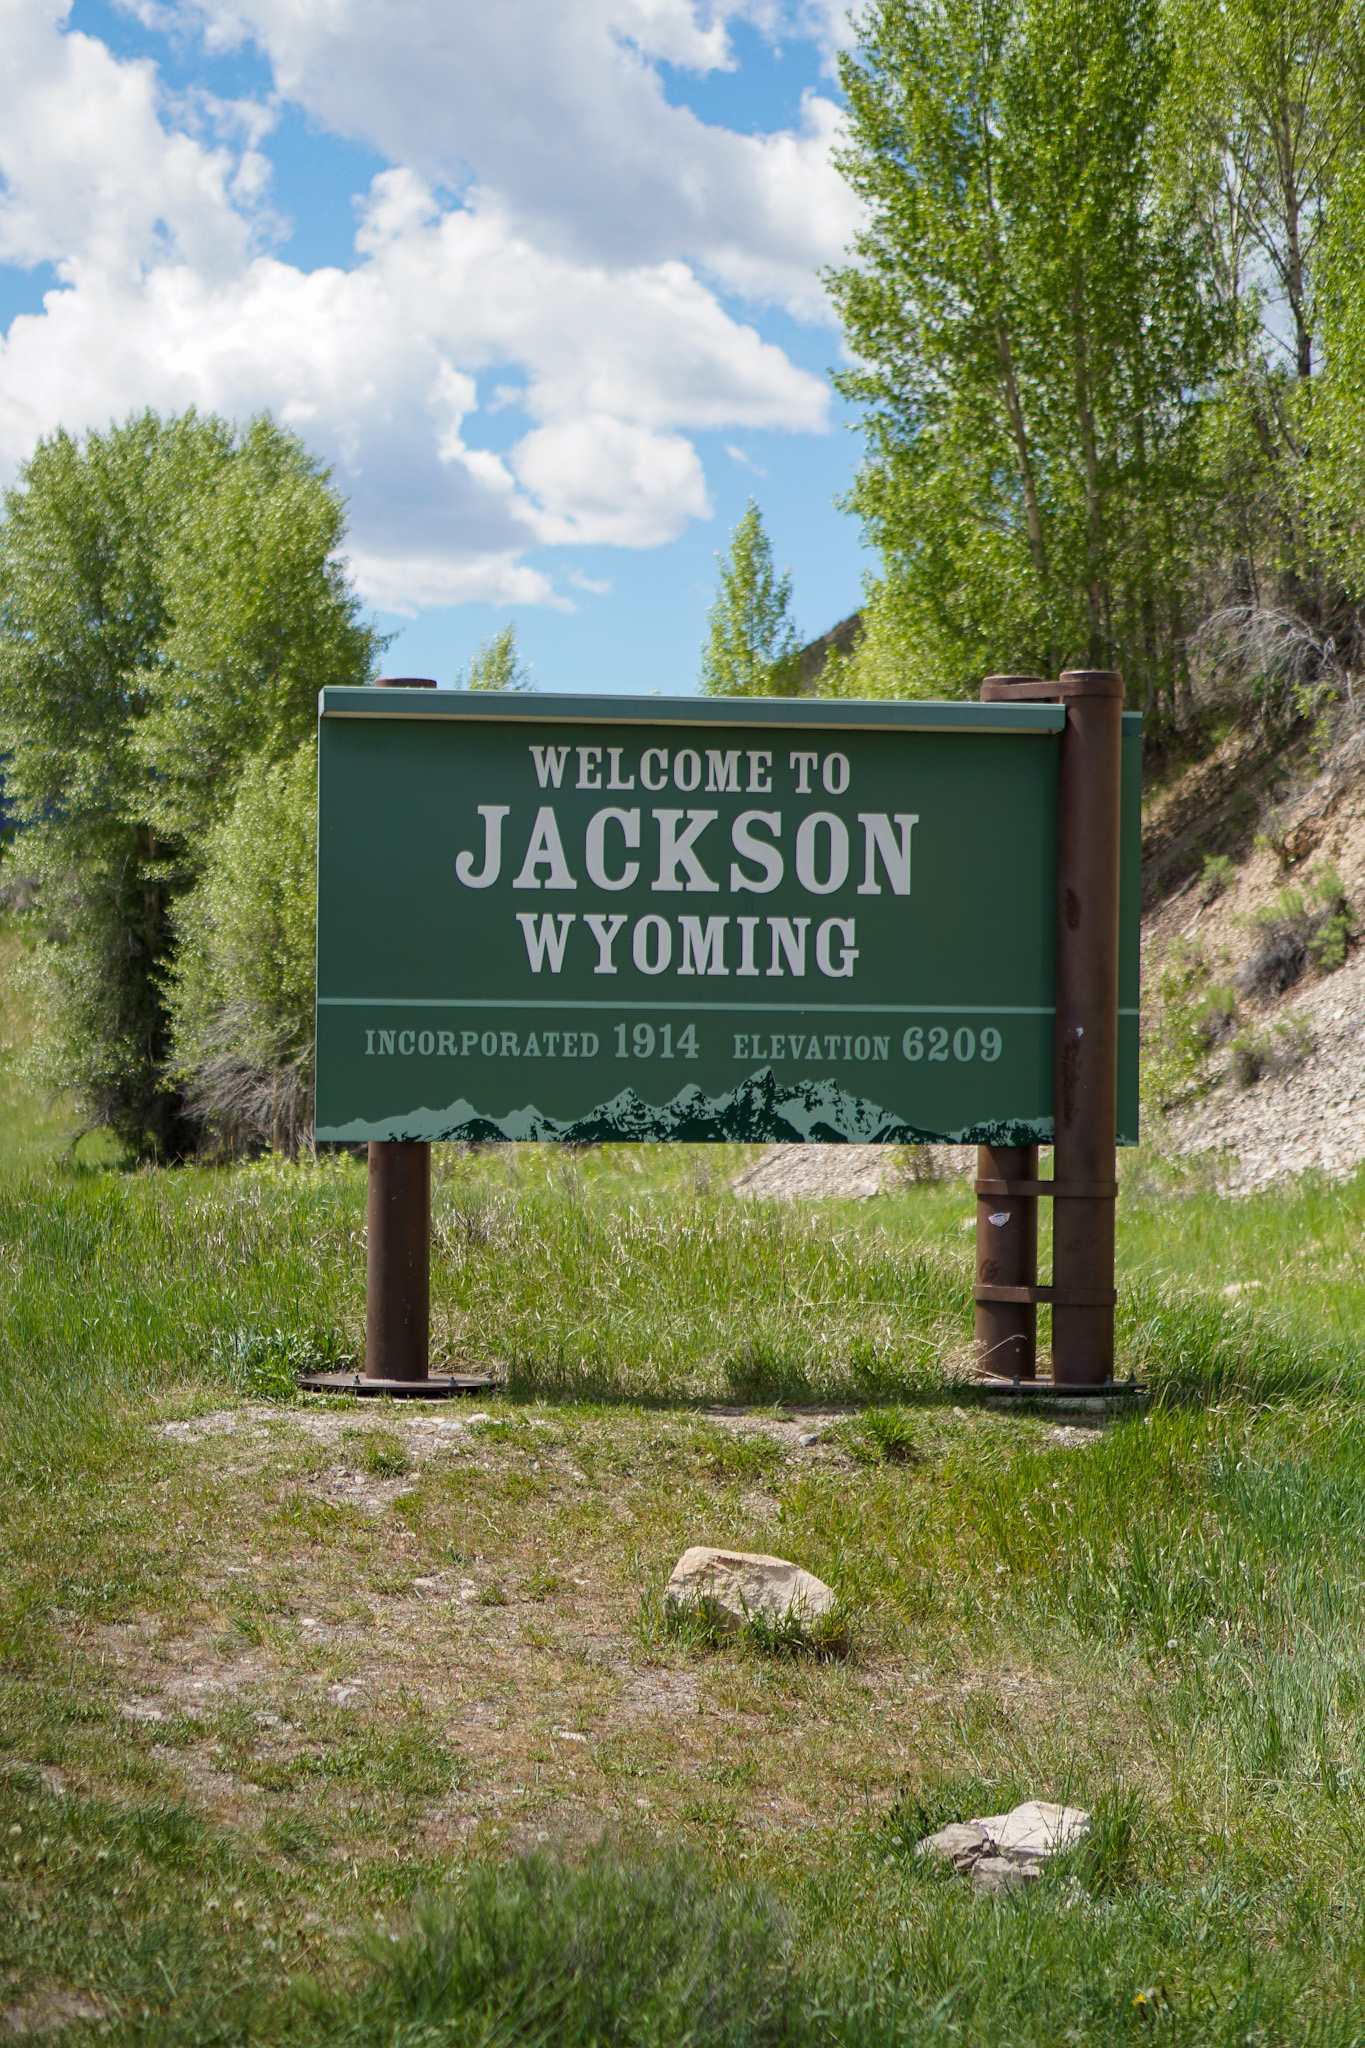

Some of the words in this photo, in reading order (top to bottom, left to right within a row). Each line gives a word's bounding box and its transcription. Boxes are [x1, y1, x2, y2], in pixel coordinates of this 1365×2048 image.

[528, 746, 772, 793] WELCOME
[790, 752, 851, 795] TO
[455, 805, 919, 896] JACKSON
[515, 913, 860, 978] WYOMING
[365, 1030, 599, 1058] INCORPORATED
[613, 1023, 700, 1059] 1914
[733, 1034, 891, 1061] ELEVATION
[902, 1026, 1003, 1062] 6209
